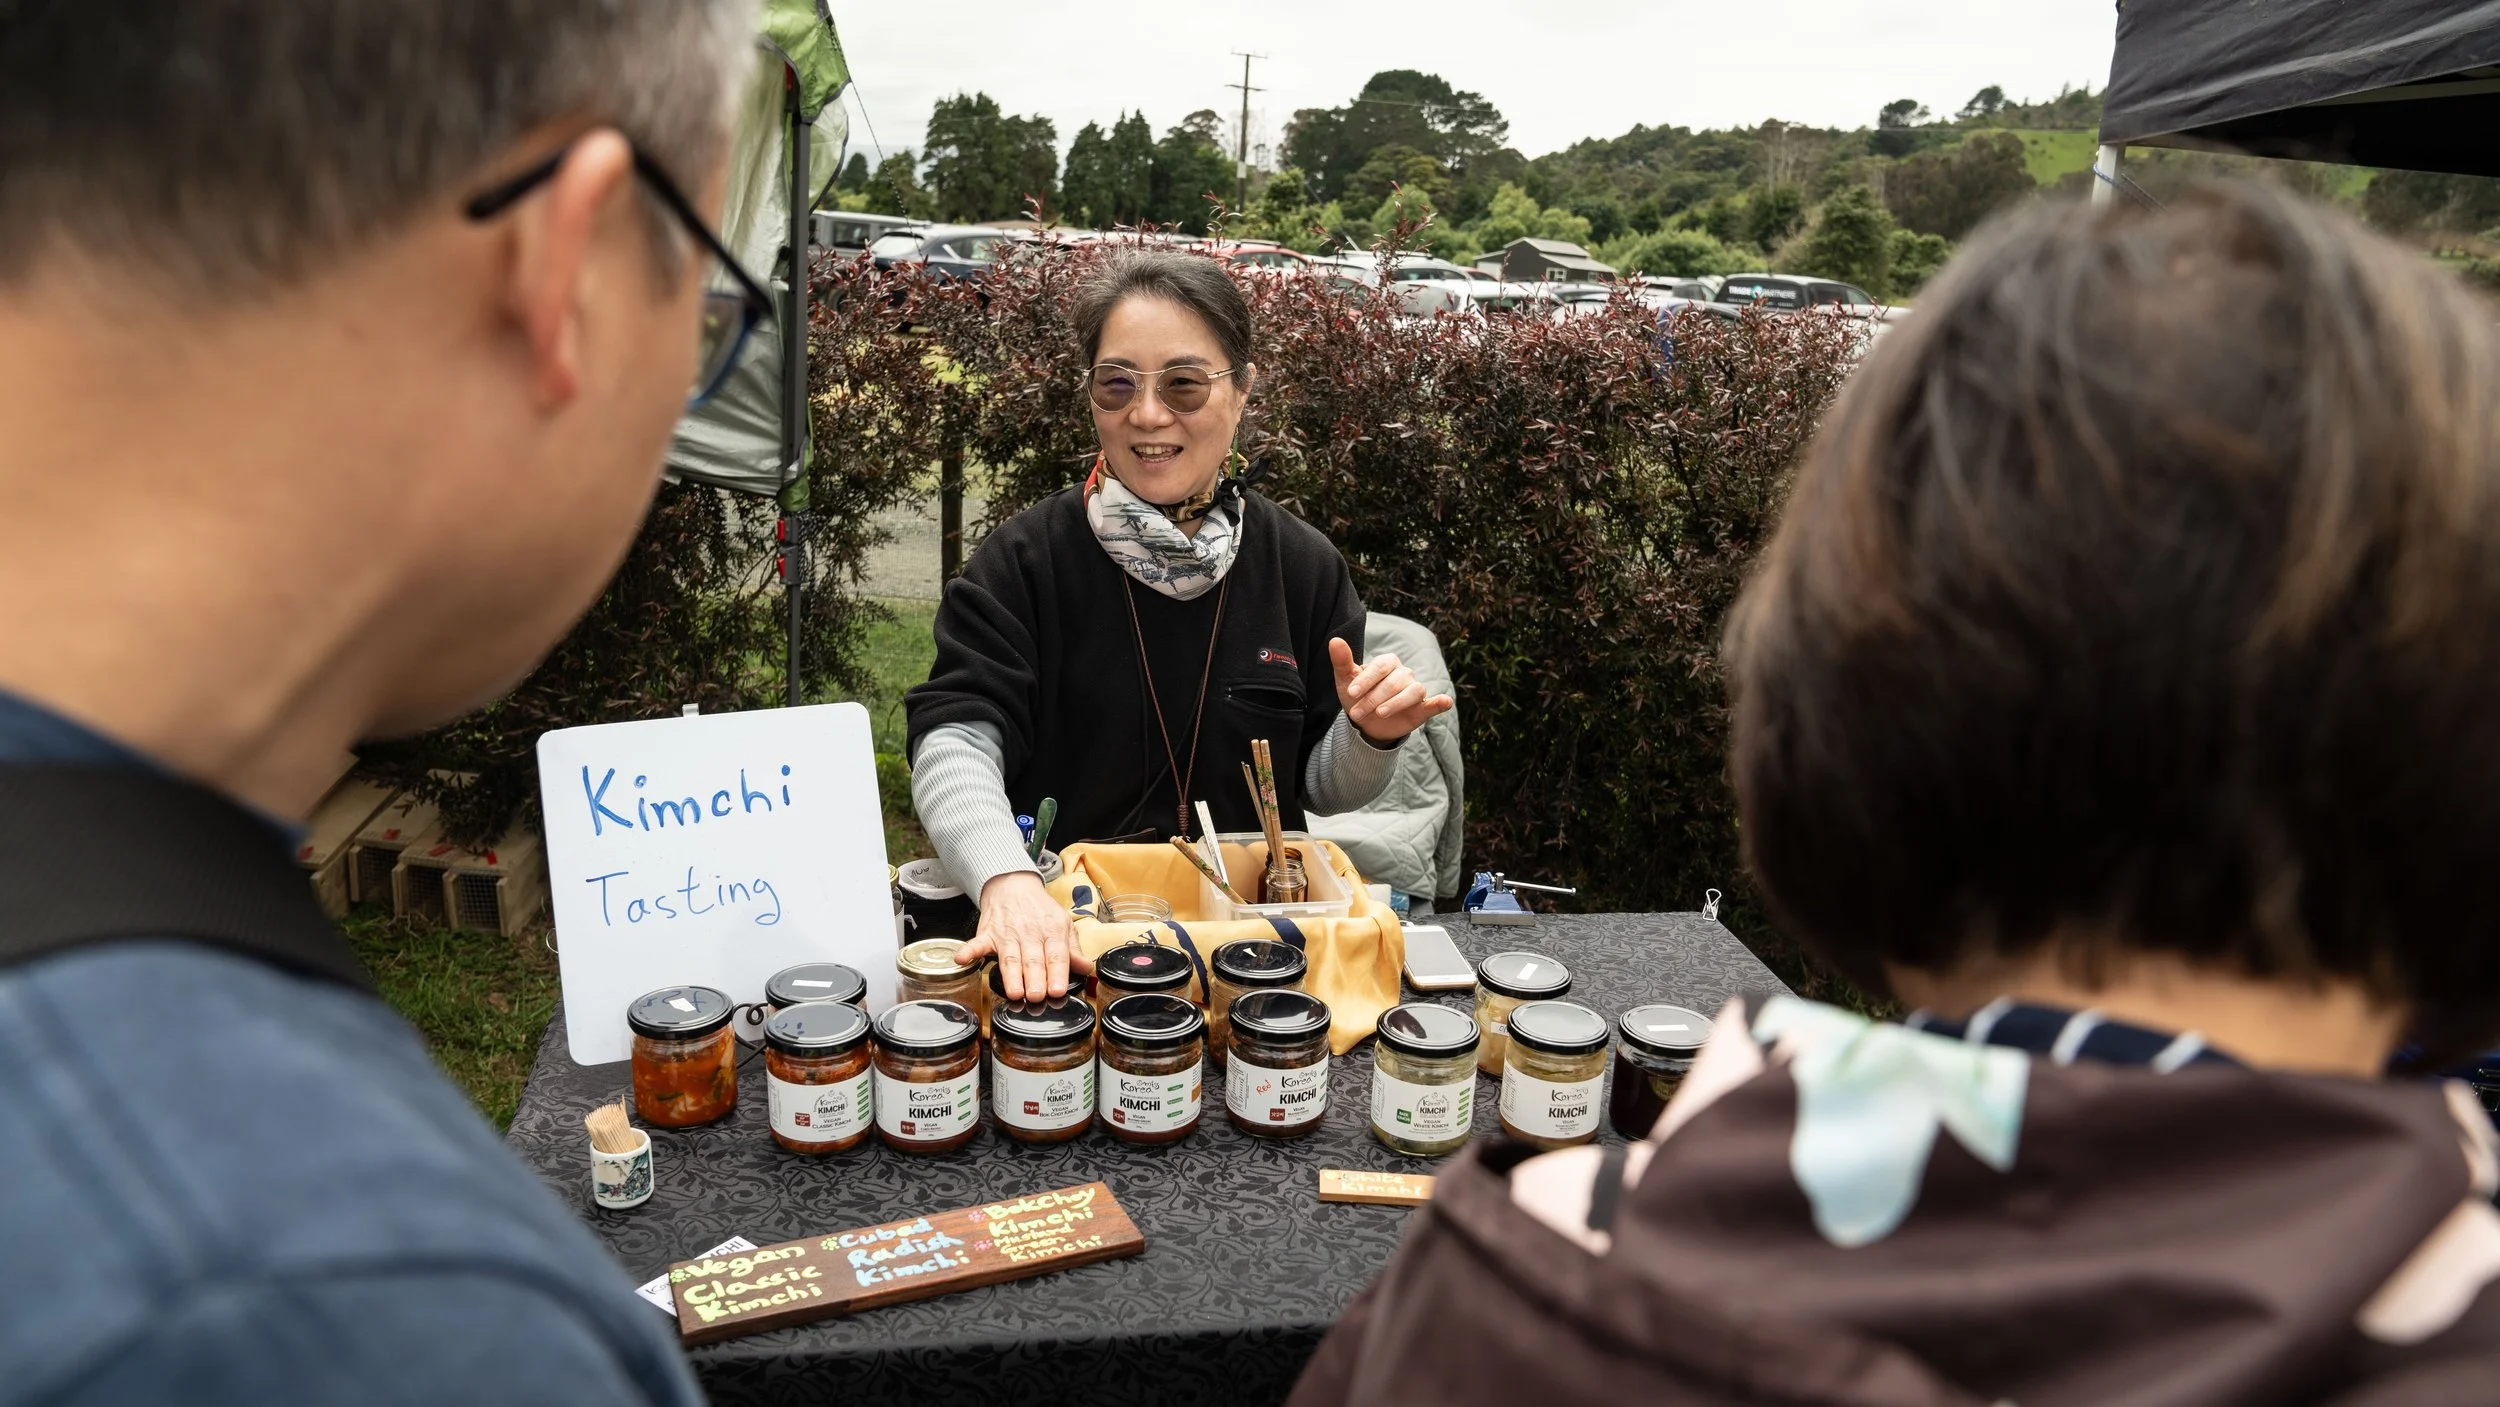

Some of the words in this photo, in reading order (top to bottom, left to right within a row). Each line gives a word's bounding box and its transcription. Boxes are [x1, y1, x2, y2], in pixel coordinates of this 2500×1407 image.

[582, 765, 790, 836] Kimchi
[586, 866, 780, 926] Tasting
[1120, 1078, 1154, 1093] Korea
[1281, 1076, 1312, 1088] Korea
[909, 1089, 944, 1101] Korea
[1047, 1093, 1073, 1102] KIMCHI
[1119, 1096, 1161, 1111] KIMCHI
[1279, 1088, 1317, 1105] KIMCHI
[1551, 1089, 1583, 1102] Korea
[818, 1104, 846, 1114] KIMCHI
[908, 1105, 952, 1119] KIMCHI
[1419, 1107, 1446, 1115] KIMCHI
[1548, 1104, 1588, 1118] KIMCHI
[988, 1206, 1094, 1237] Kimchi
[839, 1217, 934, 1248] Cubed
[993, 1222, 1076, 1247] Mustard
[847, 1231, 965, 1269] Radish
[1000, 1236, 1066, 1254] Green
[1009, 1235, 1103, 1263] Kimchi
[684, 1246, 806, 1278] Vegan
[855, 1249, 970, 1288] Kimchi
[683, 1265, 822, 1304] Classic
[694, 1283, 823, 1323] Kimchi
